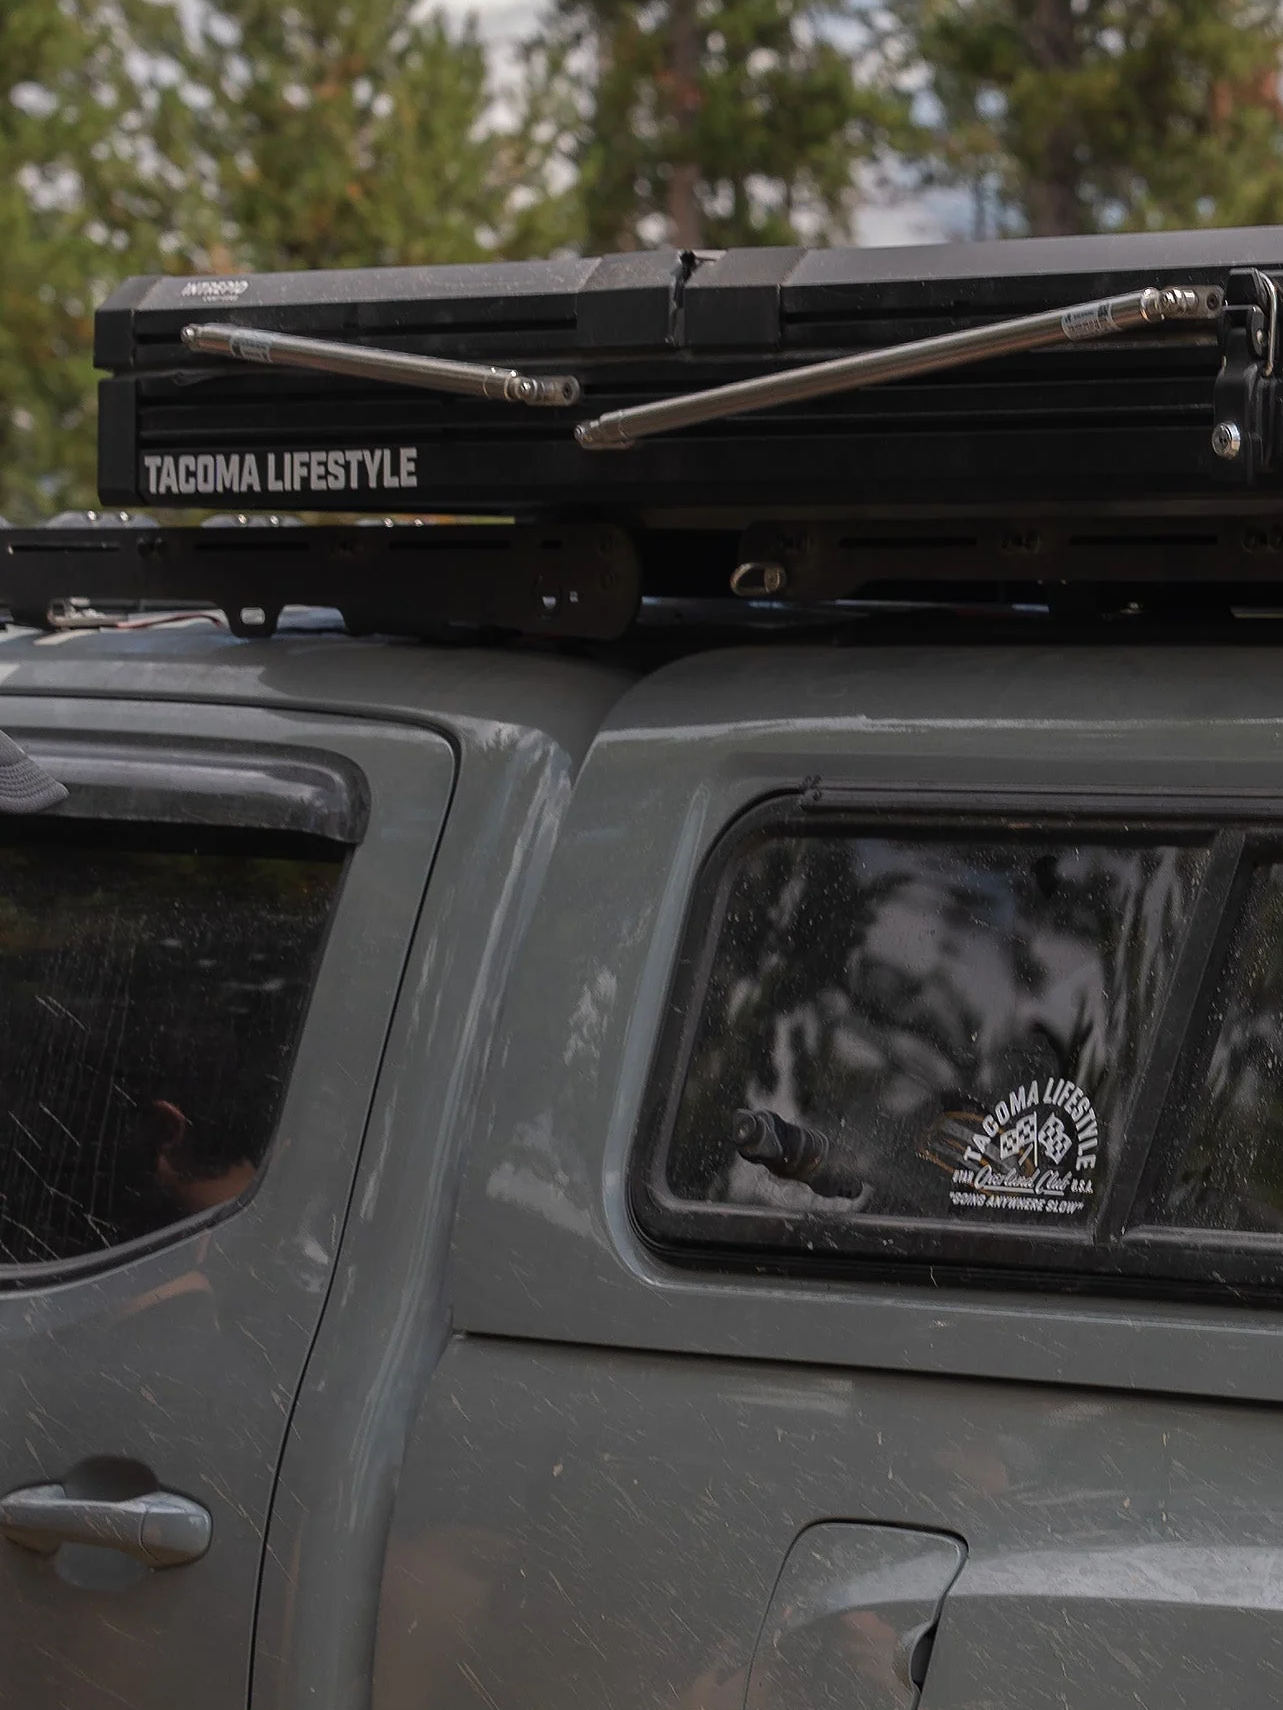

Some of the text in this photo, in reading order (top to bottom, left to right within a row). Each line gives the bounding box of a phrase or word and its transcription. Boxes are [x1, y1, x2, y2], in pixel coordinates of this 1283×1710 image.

[145, 447, 418, 494] TACOMA LIFESTYLE
[963, 1077, 1099, 1171] TACOMA LIFESTYLE
[1034, 1170, 1073, 1195] Club
